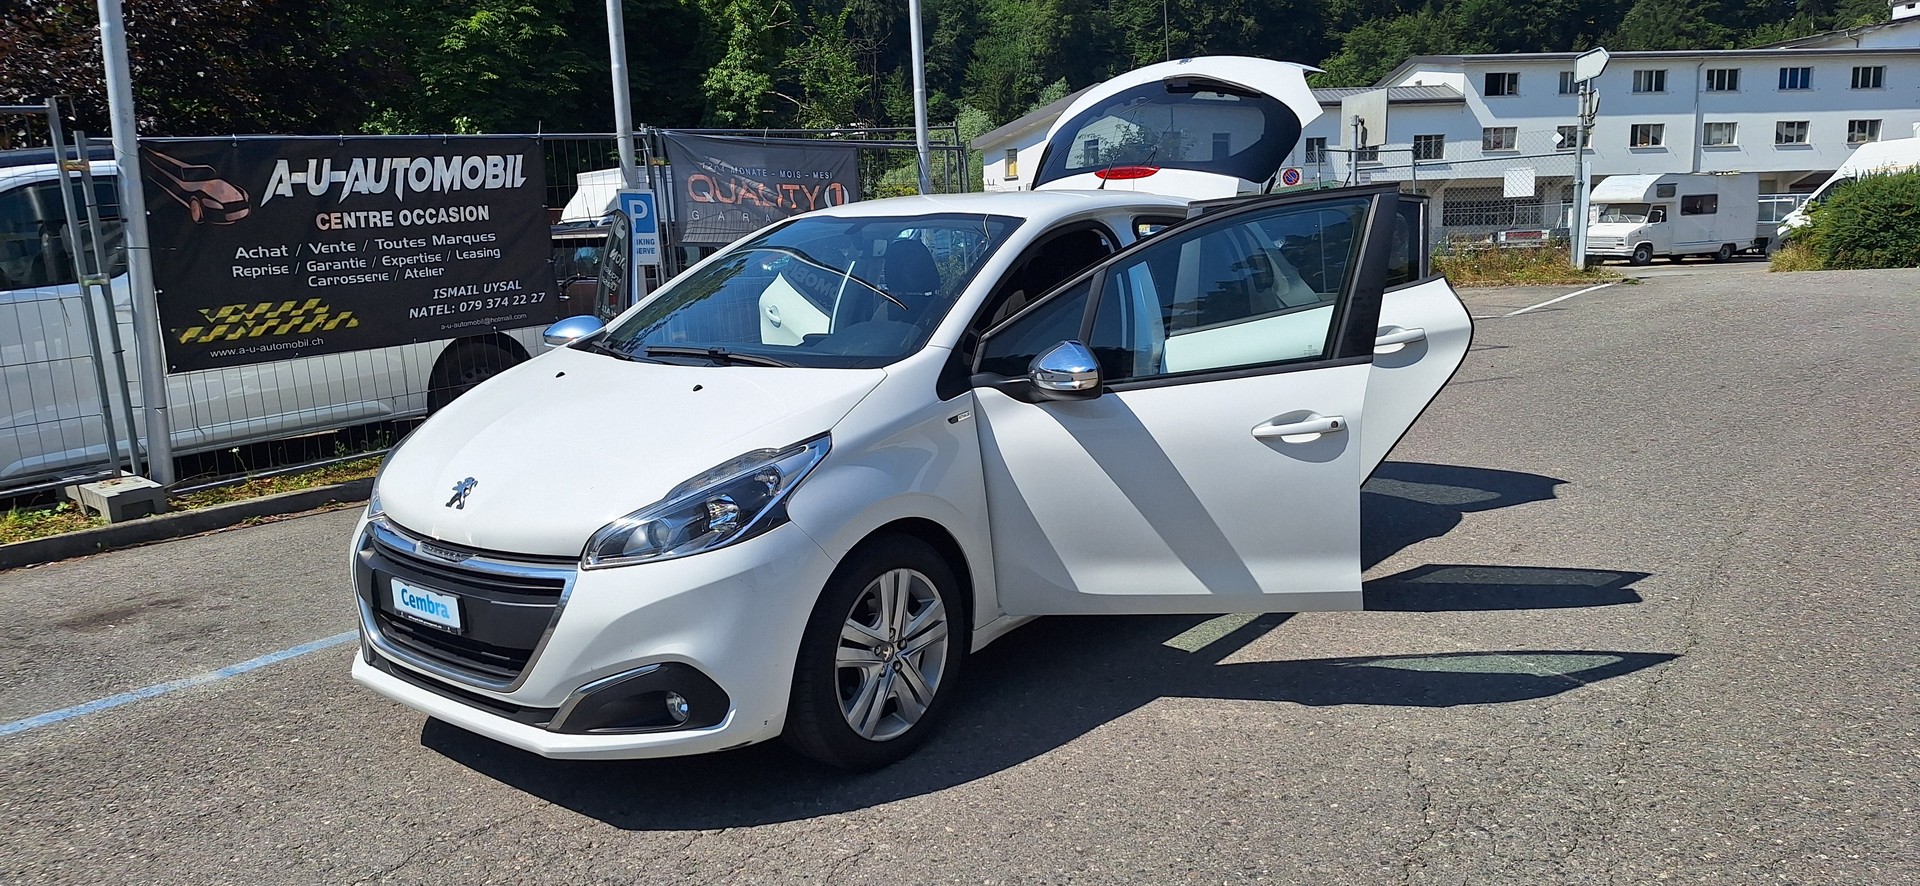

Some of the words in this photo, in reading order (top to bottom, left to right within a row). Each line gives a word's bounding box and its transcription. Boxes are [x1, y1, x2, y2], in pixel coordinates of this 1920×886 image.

[260, 155, 527, 207] A-U-AUTOMOBIL
[730, 166, 768, 177] MONATE
[779, 170, 801, 178] MOIS
[813, 171, 833, 179] MESI
[687, 172, 821, 210] QUALITY
[315, 210, 394, 231] CENTRE
[399, 205, 490, 227] OCCASION
[628, 199, 648, 230] P
[691, 210, 791, 223] GARA
[235, 245, 289, 259] Achat
[296, 244, 302, 257] /
[308, 241, 356, 255] Vente
[362, 239, 369, 252] /
[374, 237, 427, 251] Toutes
[432, 232, 497, 247] Marques
[636, 238, 655, 246] KING
[232, 263, 290, 279] Reprise
[294, 262, 300, 275] /
[306, 258, 367, 273] Garantie
[381, 252, 442, 268] Expertise
[455, 247, 501, 261] Leasing
[308, 271, 390, 288] Carrosserie
[404, 265, 445, 280] Atelier
[433, 285, 480, 300] ISMAIL
[483, 280, 522, 294] UYSAL
[409, 304, 455, 319] NATEL:
[459, 300, 483, 313] 079
[486, 297, 509, 310] 374
[512, 294, 527, 306] 22
[530, 292, 546, 304] 27
[440, 312, 527, 330] a-u-automobil@hotmail.com
[210, 337, 324, 358] www.a-u-automobil.ch
[401, 588, 450, 619] Cembra
